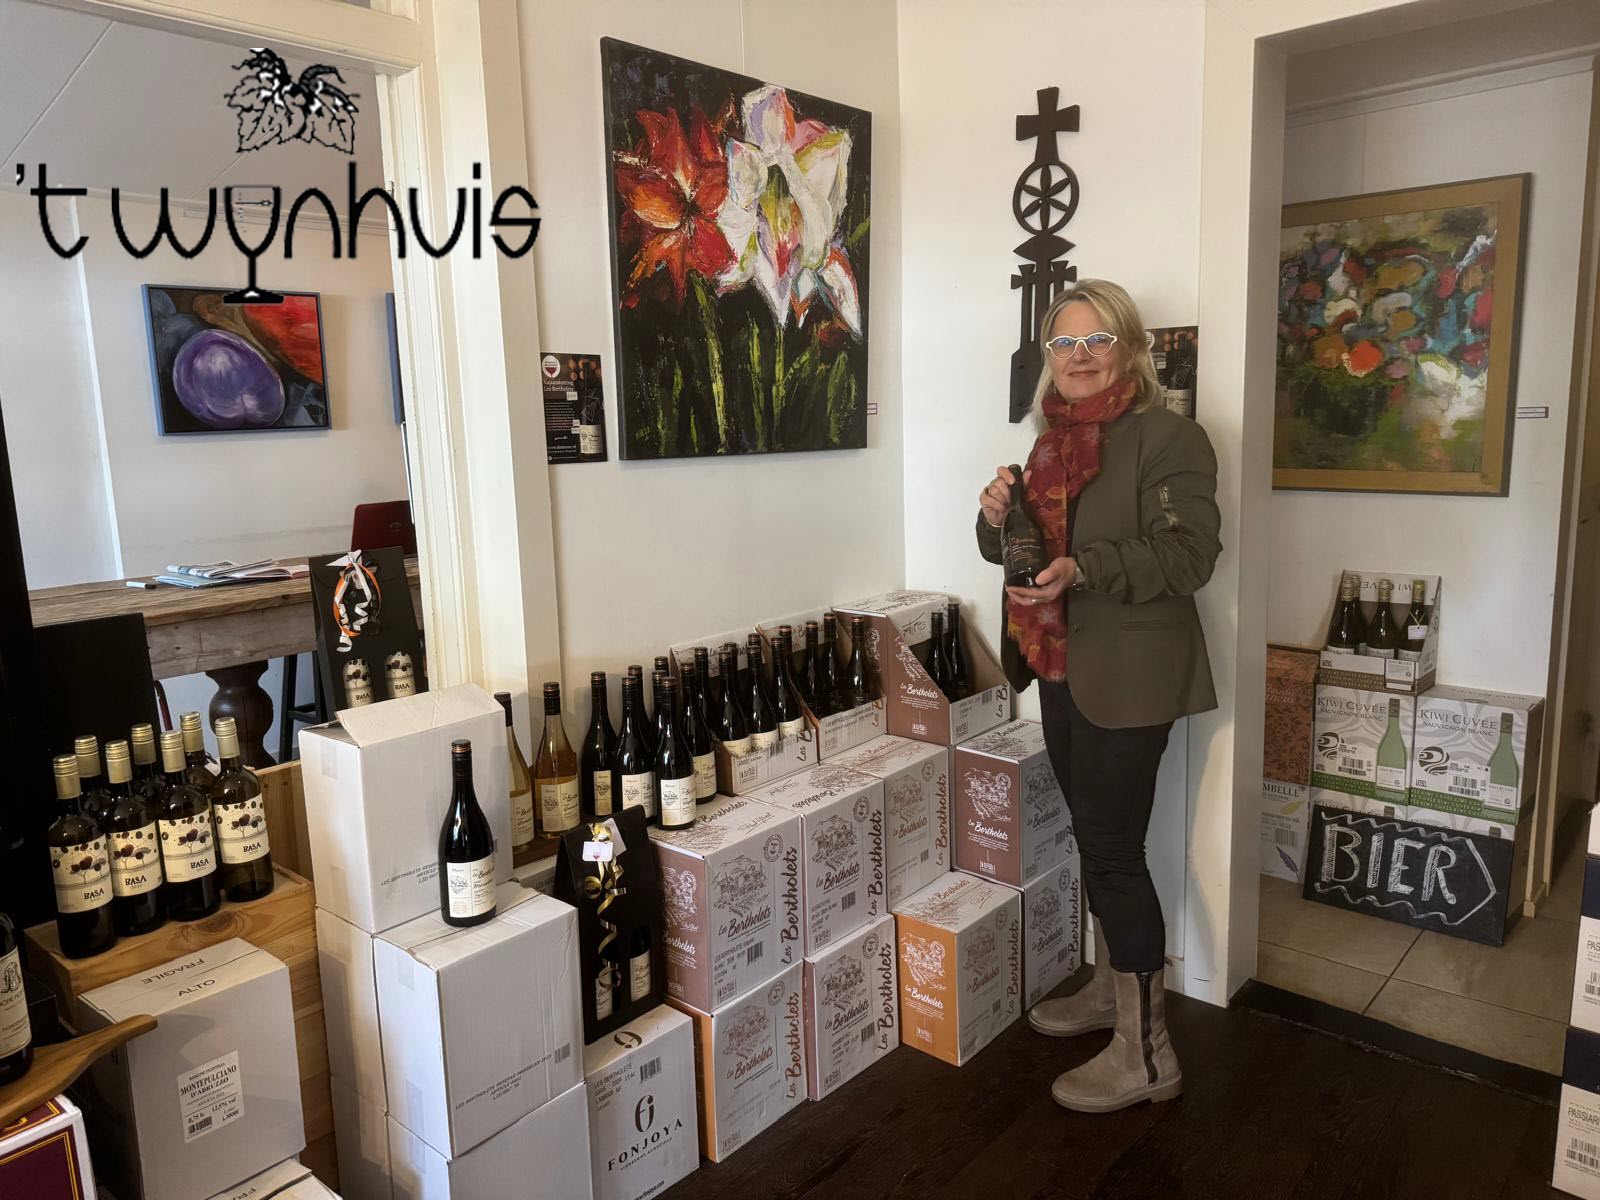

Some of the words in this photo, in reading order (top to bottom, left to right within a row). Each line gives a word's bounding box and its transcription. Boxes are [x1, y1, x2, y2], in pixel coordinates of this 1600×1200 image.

[907, 683, 938, 699] Bertholets
[1318, 697, 1343, 707] KIWI
[1320, 708, 1359, 718] SAUVIGNON
[1360, 713, 1384, 721] BLANC
[1420, 709, 1448, 722] KIWI
[1423, 720, 1466, 733] SAUVIGNON
[1468, 727, 1494, 737] BLANC
[1261, 783, 1301, 798] MBELLE
[936, 774, 948, 850] Bertholets
[975, 821, 1008, 841] Bertholets
[867, 808, 883, 897] Bertholets
[1321, 824, 1457, 905] BIER
[823, 862, 860, 891] Bertholets
[781, 846, 799, 944] Bertholets
[868, 899, 878, 917] Les
[727, 907, 772, 938] Bertholets
[1068, 877, 1079, 954] Bertholets
[781, 945, 792, 964] Les
[1007, 918, 1020, 996] Bertholets
[1587, 940, 1600, 951] PAS
[142, 958, 205, 985] FRAGILE
[178, 979, 215, 997] ALTO
[877, 942, 894, 1032] Bertholets
[911, 986, 944, 1009] Bertholets
[833, 998, 870, 1031] Bertholets
[784, 991, 802, 1082] Bertholets
[878, 1033, 888, 1050] Les
[735, 1046, 773, 1080] Bertholets
[180, 1064, 237, 1097] MONTEPULCIANO
[786, 1082, 796, 1099] Les
[607, 1118, 682, 1172] FONJOYA
